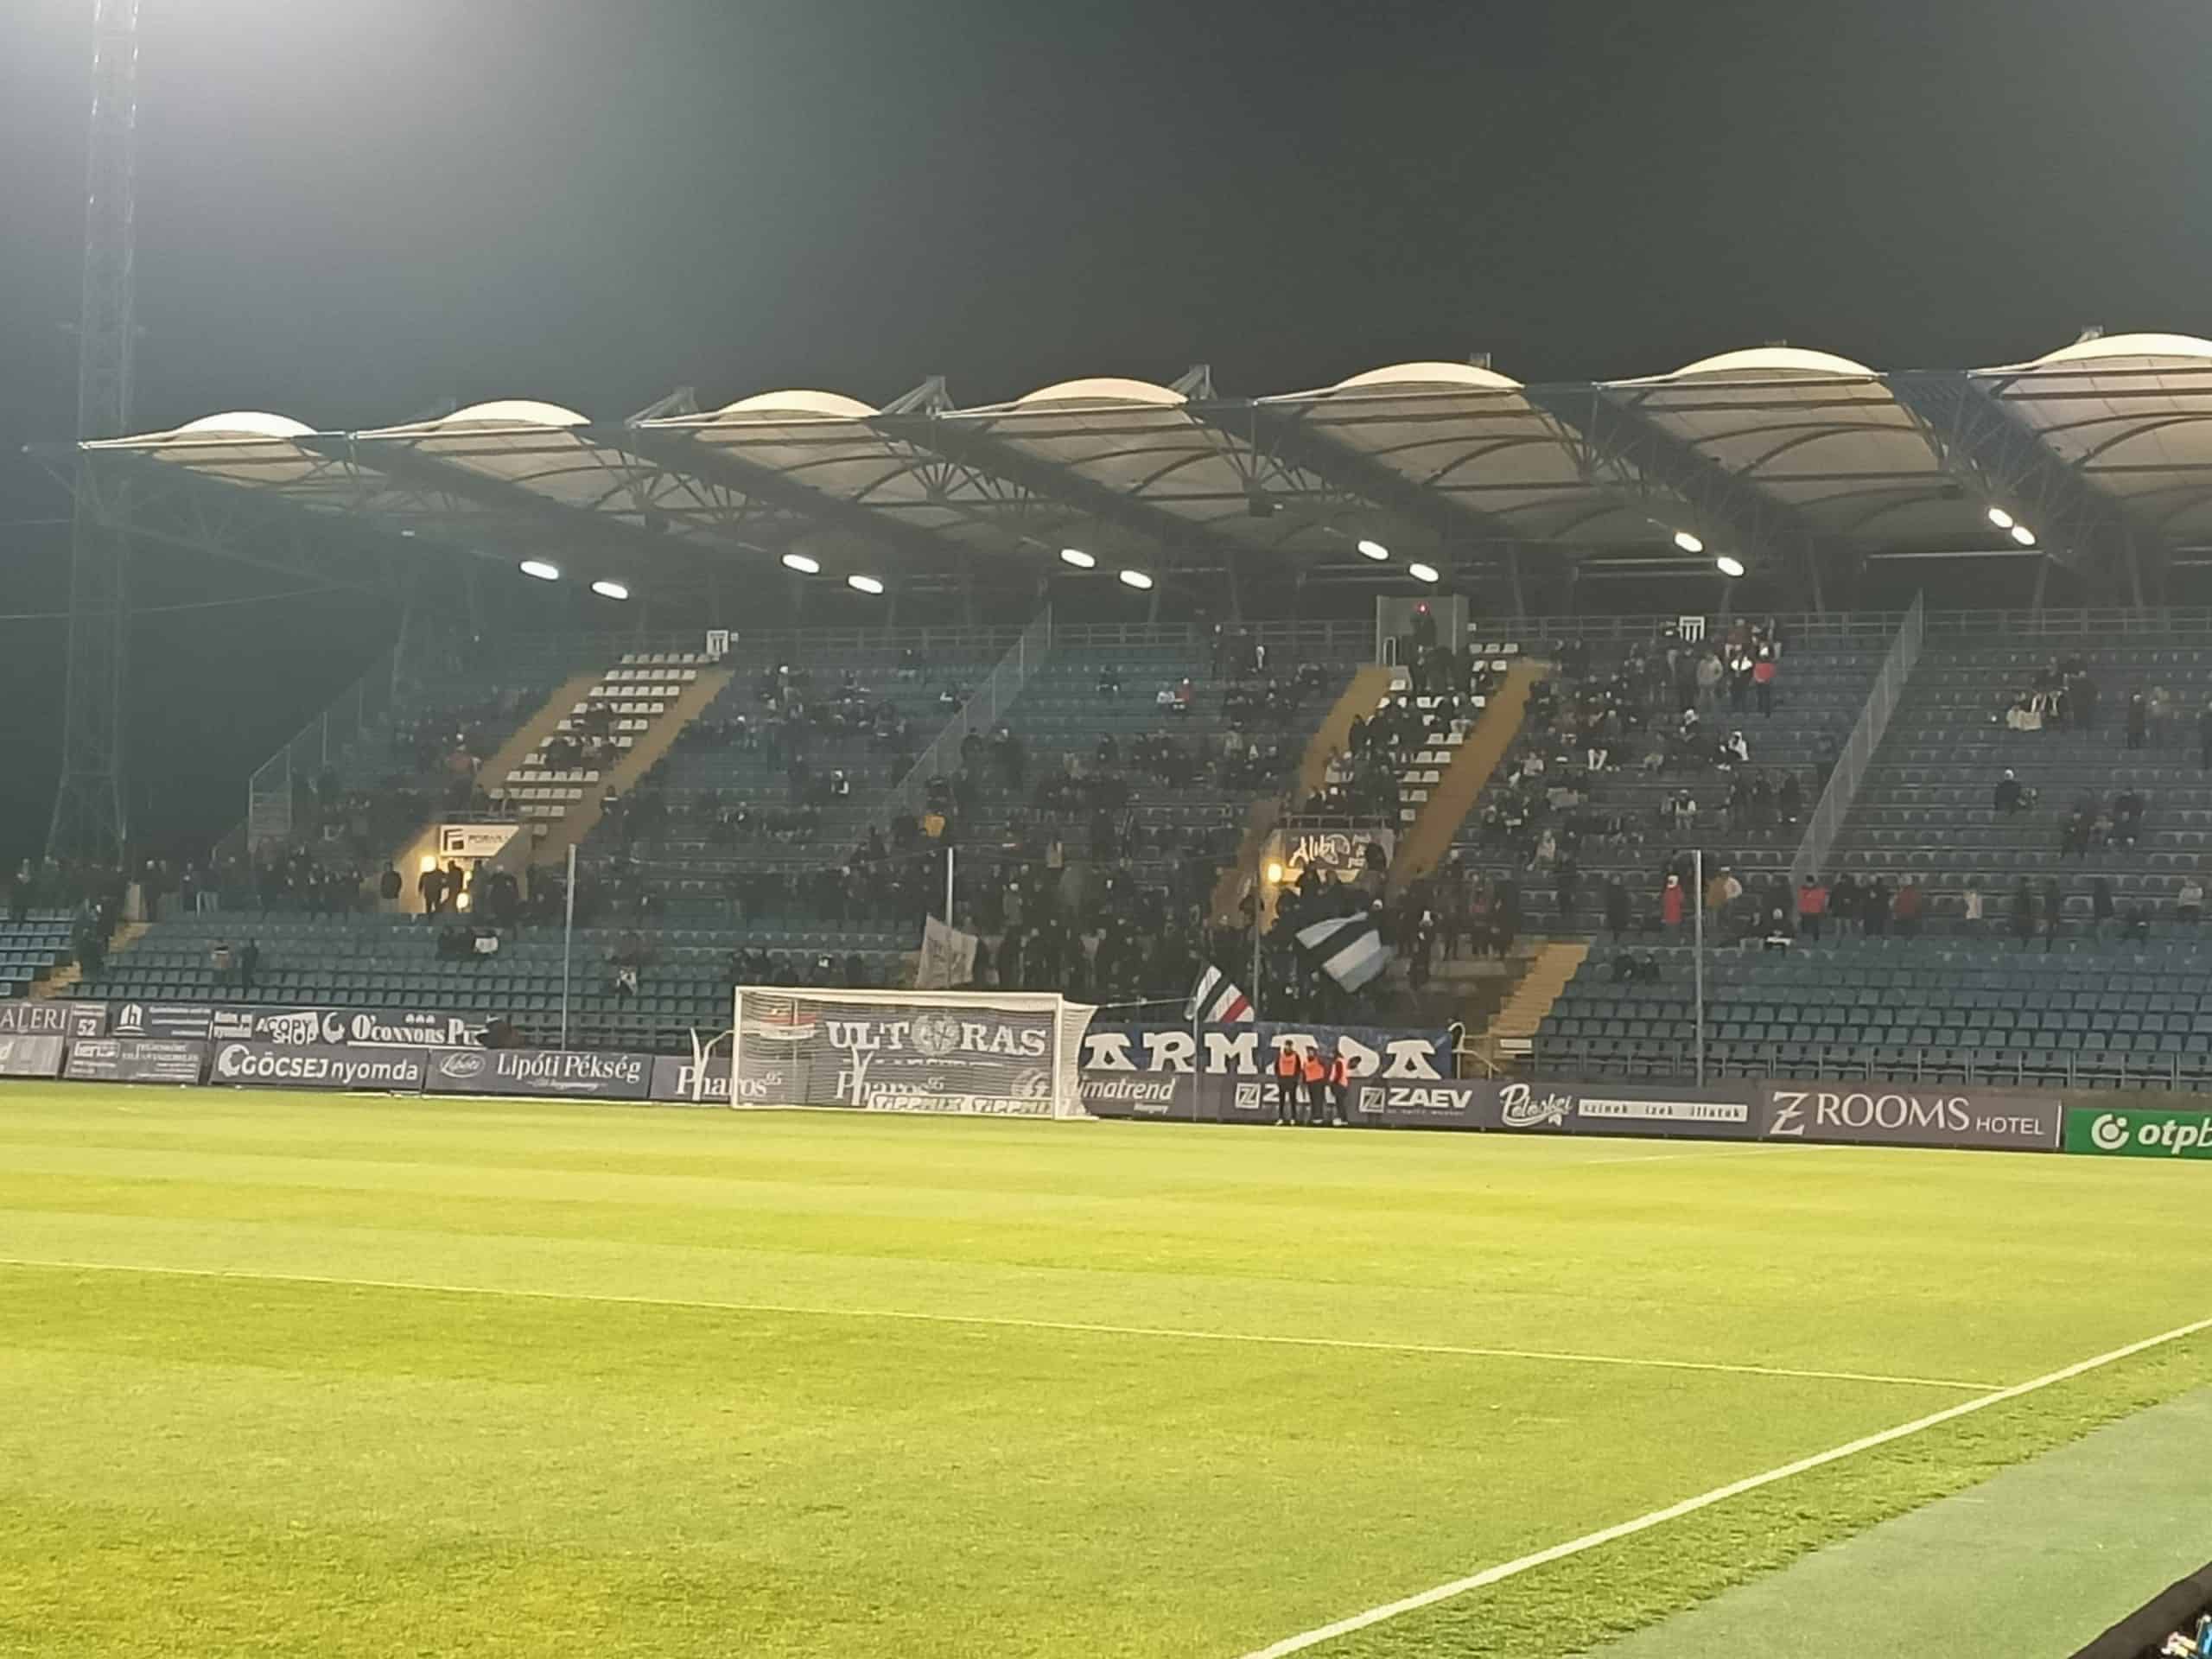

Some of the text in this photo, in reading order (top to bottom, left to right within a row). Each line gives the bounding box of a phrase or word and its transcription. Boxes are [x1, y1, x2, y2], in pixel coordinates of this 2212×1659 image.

[77, 1019, 97, 1036] 52
[331, 1058, 419, 1084] nyomda
[497, 1052, 642, 1084] Lipóti Pékség
[1080, 1077, 1176, 1101] imatrend
[1387, 1087, 1473, 1109] ZAEV
[1815, 1092, 1971, 1132] ROOMS
[1975, 1116, 2047, 1135] HOTEL
